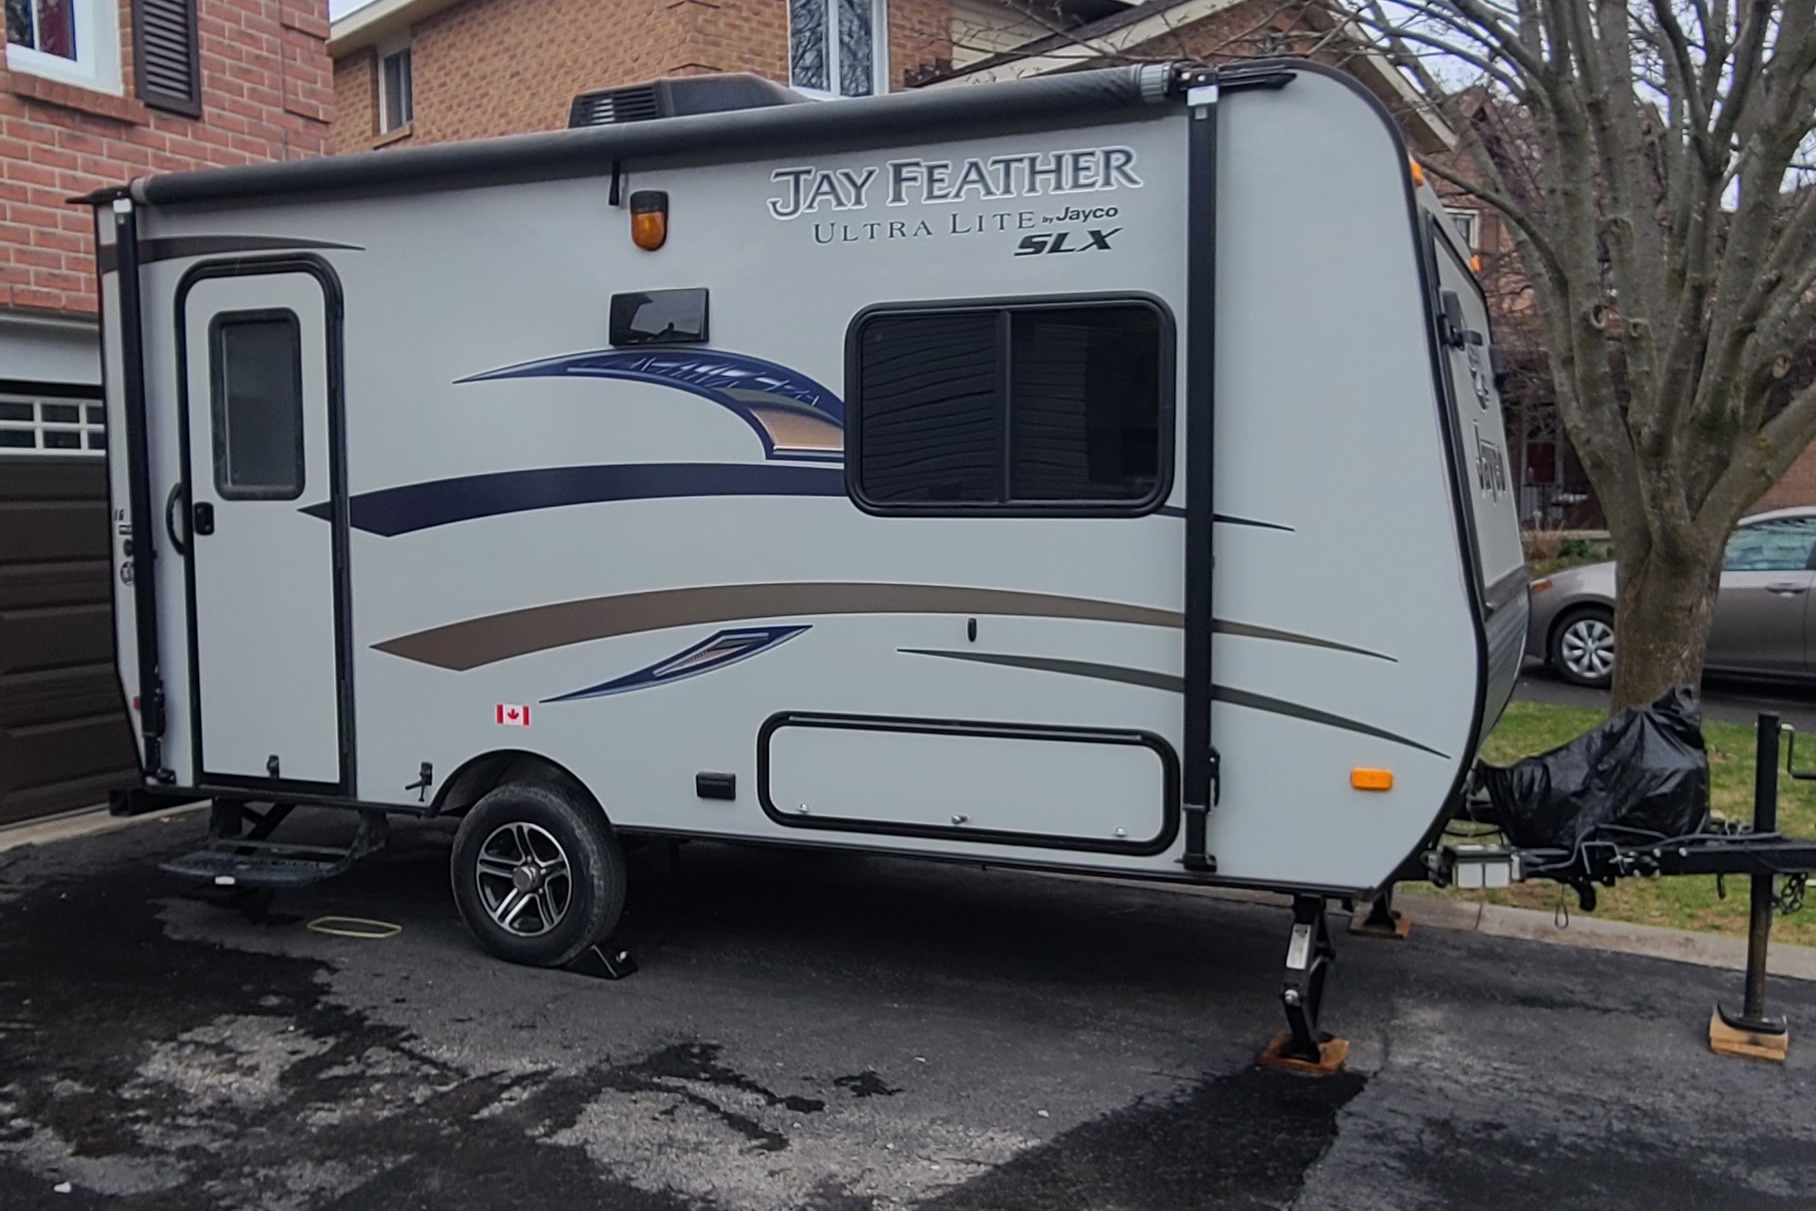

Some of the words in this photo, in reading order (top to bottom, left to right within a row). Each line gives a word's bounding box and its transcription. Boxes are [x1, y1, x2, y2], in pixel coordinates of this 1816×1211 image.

[767, 165, 878, 220] JAY
[887, 146, 1143, 207] FEATHER
[813, 219, 933, 244] ULTRA
[949, 211, 1035, 234] LITE
[1042, 216, 1054, 224] by
[1055, 206, 1118, 223] Jayco
[1014, 227, 1123, 256] SLX
